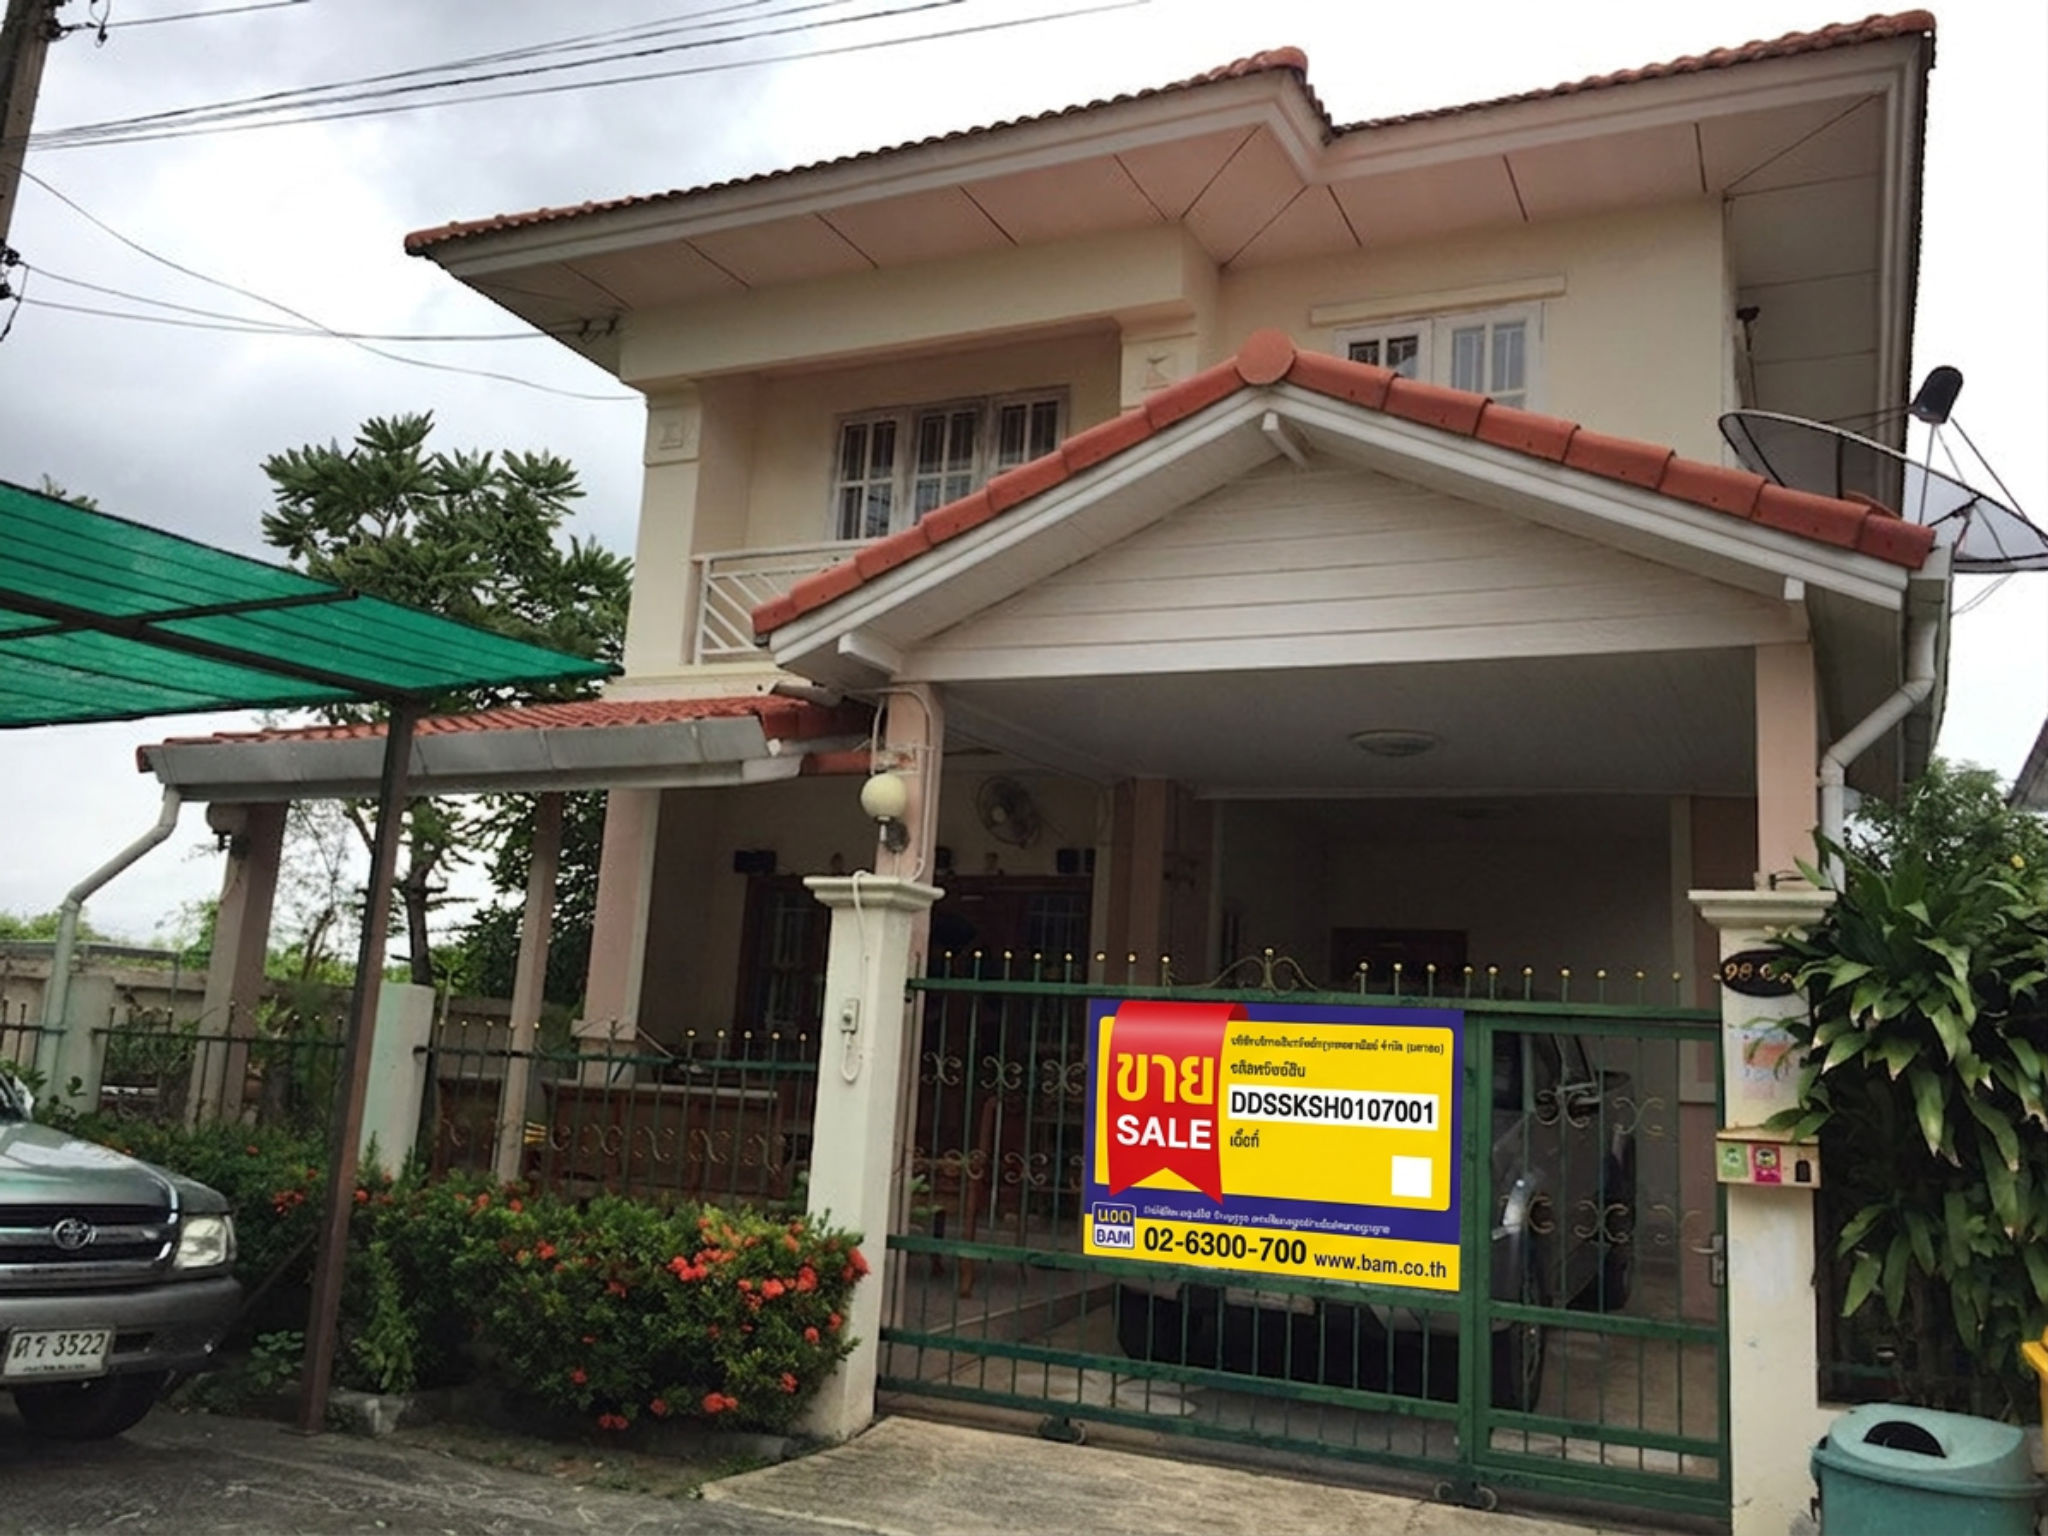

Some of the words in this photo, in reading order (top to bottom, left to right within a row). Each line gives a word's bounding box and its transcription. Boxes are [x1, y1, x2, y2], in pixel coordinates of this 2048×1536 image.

[1117, 1053, 1214, 1105] ขาย
[1231, 1091, 1434, 1124] DDSSKSH0107001
[1116, 1114, 1212, 1150] SALE
[1144, 1226, 1307, 1264] 02-6300-700
[1314, 1251, 1447, 1278] www.bam.co.th
[52, 1332, 106, 1357] 3522
